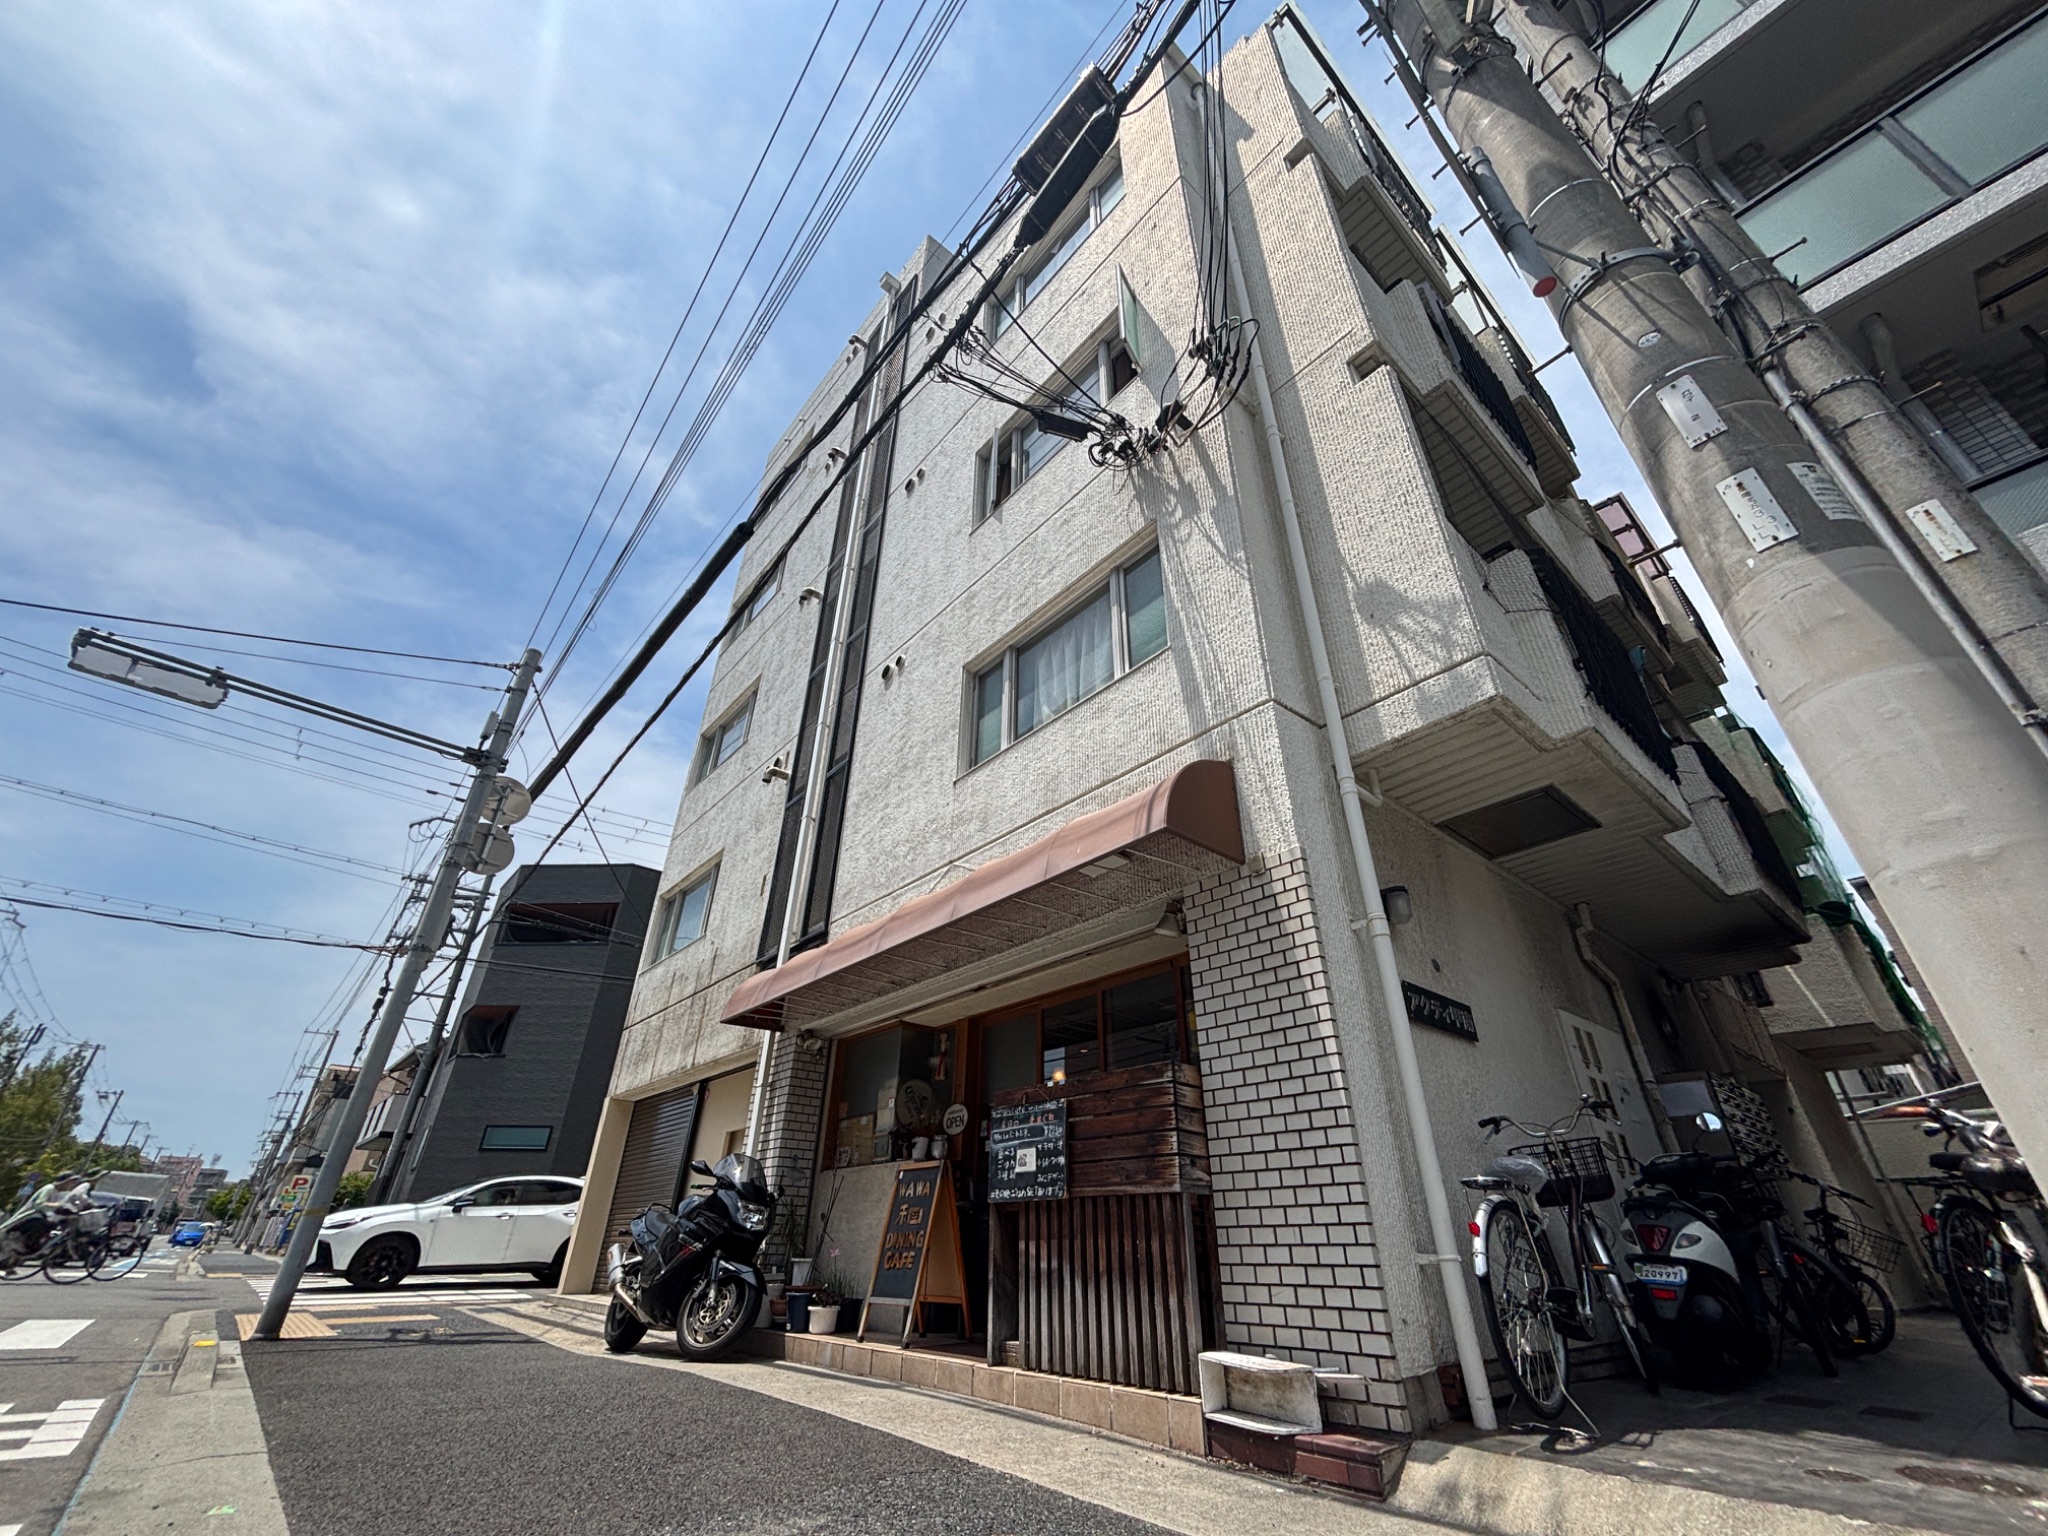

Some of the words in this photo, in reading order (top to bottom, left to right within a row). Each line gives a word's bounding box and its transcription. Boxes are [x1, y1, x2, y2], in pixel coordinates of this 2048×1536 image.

[946, 1114, 965, 1129] OPEN
[291, 1177, 309, 1190] P
[899, 1181, 931, 1198] WAWA
[895, 1203, 923, 1226] 和
[885, 1230, 926, 1249] DINING
[883, 1250, 916, 1270] CAFE
